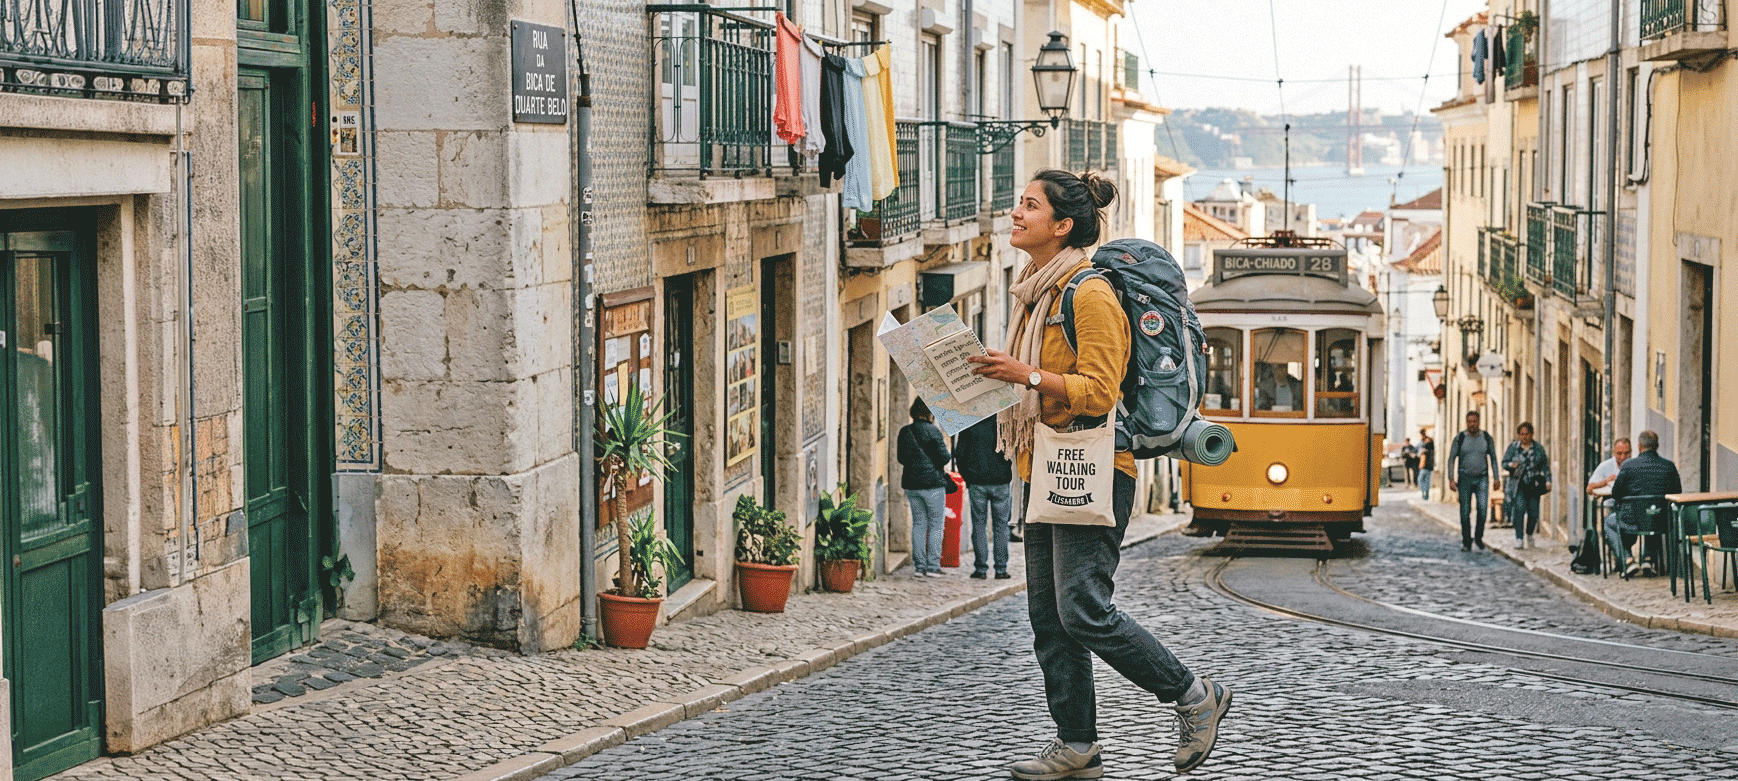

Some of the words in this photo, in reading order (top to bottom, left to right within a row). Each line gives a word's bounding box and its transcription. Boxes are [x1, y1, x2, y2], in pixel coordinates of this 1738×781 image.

[532, 29, 548, 50] RUA
[536, 54, 545, 68] DA
[526, 72, 543, 91] BICA
[545, 74, 556, 92] DE
[515, 94, 545, 115] DUARTE
[547, 97, 566, 116] BELO
[1224, 256, 1296, 270] BICA-CHIADO
[1310, 257, 1332, 271] 28
[1057, 448, 1085, 461] FREE
[1046, 460, 1096, 476] WALAING
[1055, 476, 1085, 490] TOUR
